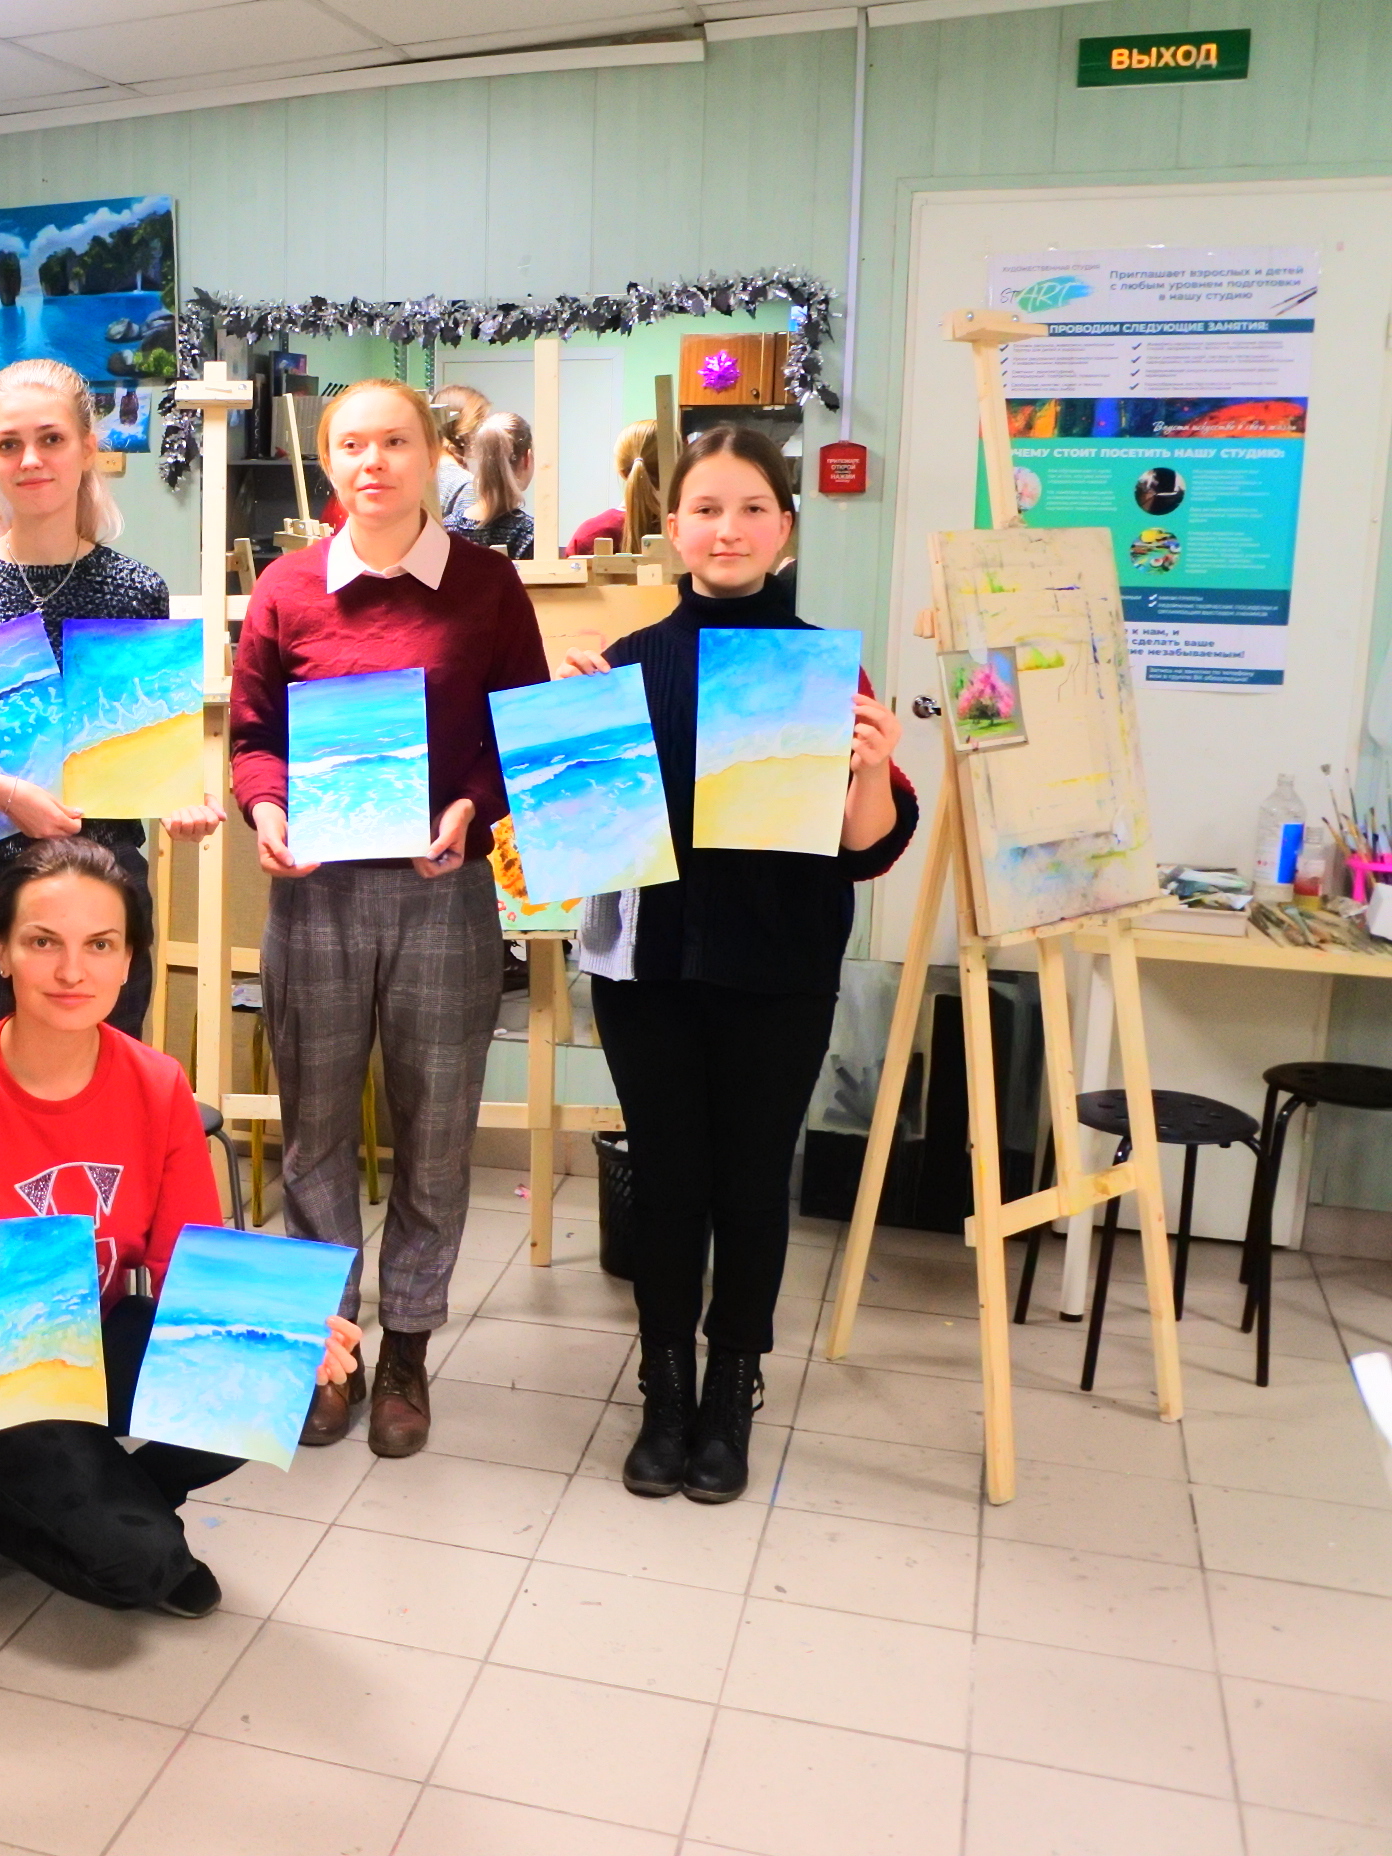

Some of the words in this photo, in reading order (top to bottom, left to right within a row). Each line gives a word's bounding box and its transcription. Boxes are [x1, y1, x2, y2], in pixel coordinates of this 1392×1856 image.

[1110, 43, 1218, 70] ВЫХОД
[1109, 269, 1185, 280] Приглашает
[1189, 268, 1250, 279] взрослых
[1255, 268, 1263, 276] и
[1265, 266, 1304, 276] детей
[1110, 282, 1117, 290] с
[1120, 280, 1165, 290] любым
[1168, 281, 1223, 291] уровнем
[1226, 278, 1301, 289] подготовки
[1158, 293, 1165, 301] в
[1169, 292, 1201, 303] нашу
[1205, 291, 1253, 301] студию
[1049, 324, 1120, 334] ПРОВОДИМ
[1122, 322, 1205, 334] СЛЕДУЮЩИЕ
[1207, 321, 1269, 331] ЗАНЯТИЯ:
[1011, 448, 1051, 458] ЧЕМУ
[1053, 448, 1099, 458] СТОИТ
[1100, 448, 1172, 459] ПОСЕТИТЬ
[1174, 448, 1217, 459] НАШУ
[1219, 448, 1286, 460] СТУДИЮ:
[1142, 629, 1169, 637] нам,
[1131, 638, 1180, 647] сделать
[1184, 639, 1215, 648] ваше
[1147, 647, 1246, 659] незабываемым!
